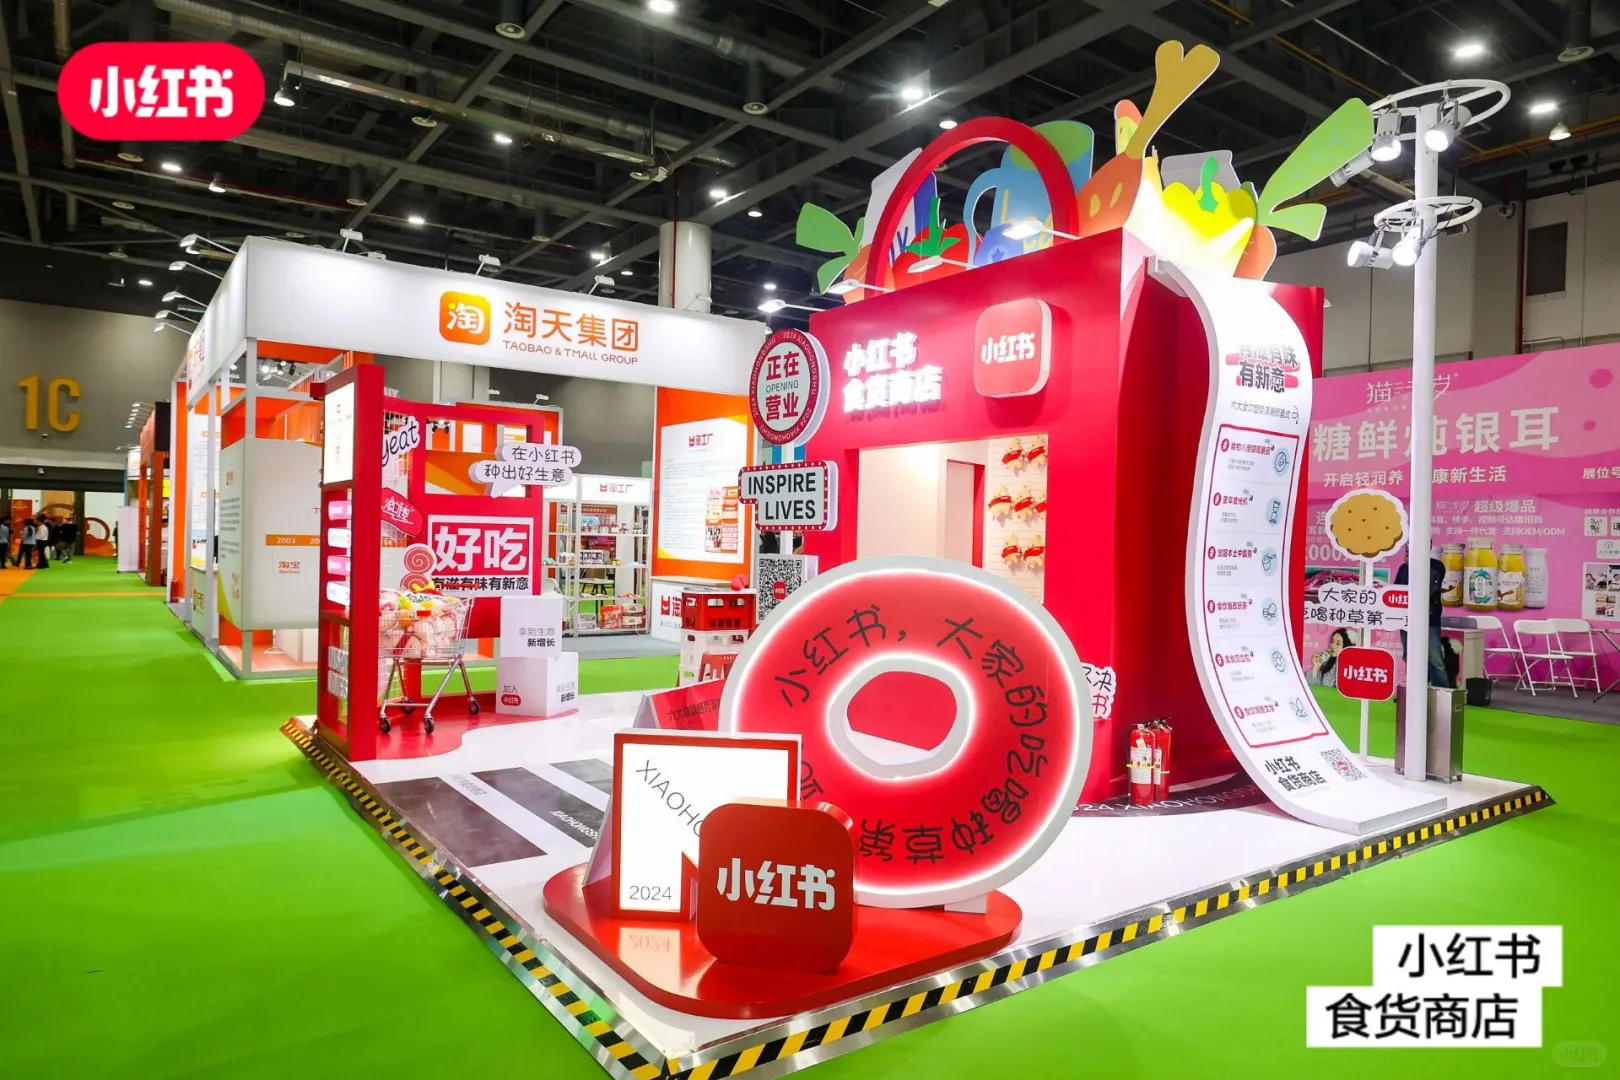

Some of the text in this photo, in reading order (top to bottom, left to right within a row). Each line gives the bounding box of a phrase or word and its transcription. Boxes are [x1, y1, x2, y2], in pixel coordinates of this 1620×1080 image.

[446, 302, 485, 335] 淘
[503, 301, 639, 352] 淘天集团
[502, 340, 552, 355] TAOBAO
[555, 347, 562, 356] &
[601, 353, 638, 365] GROUP
[843, 331, 918, 377] 小红书
[981, 332, 1036, 365] 小红书
[766, 351, 800, 380] 正在
[1239, 360, 1285, 393] 有新意
[765, 380, 799, 394] OPENING
[18, 374, 81, 432] 1C
[765, 392, 799, 421] 营业
[511, 446, 575, 464] 在小红书
[484, 463, 566, 483] 种出好生意
[748, 472, 816, 495] INSPIRE
[765, 499, 816, 520] LIVES
[1474, 500, 1536, 513] 超级爆品
[435, 526, 528, 572] 好吃
[1322, 587, 1377, 605] 大家的
[527, 637, 556, 647] 新增长
[1343, 665, 1388, 683] 小红书
[503, 684, 519, 694] 加入
[1264, 755, 1301, 776] 小红书
[1277, 769, 1329, 792] 食货商店
[629, 886, 673, 901] 2024
[717, 857, 836, 911] 小红书
